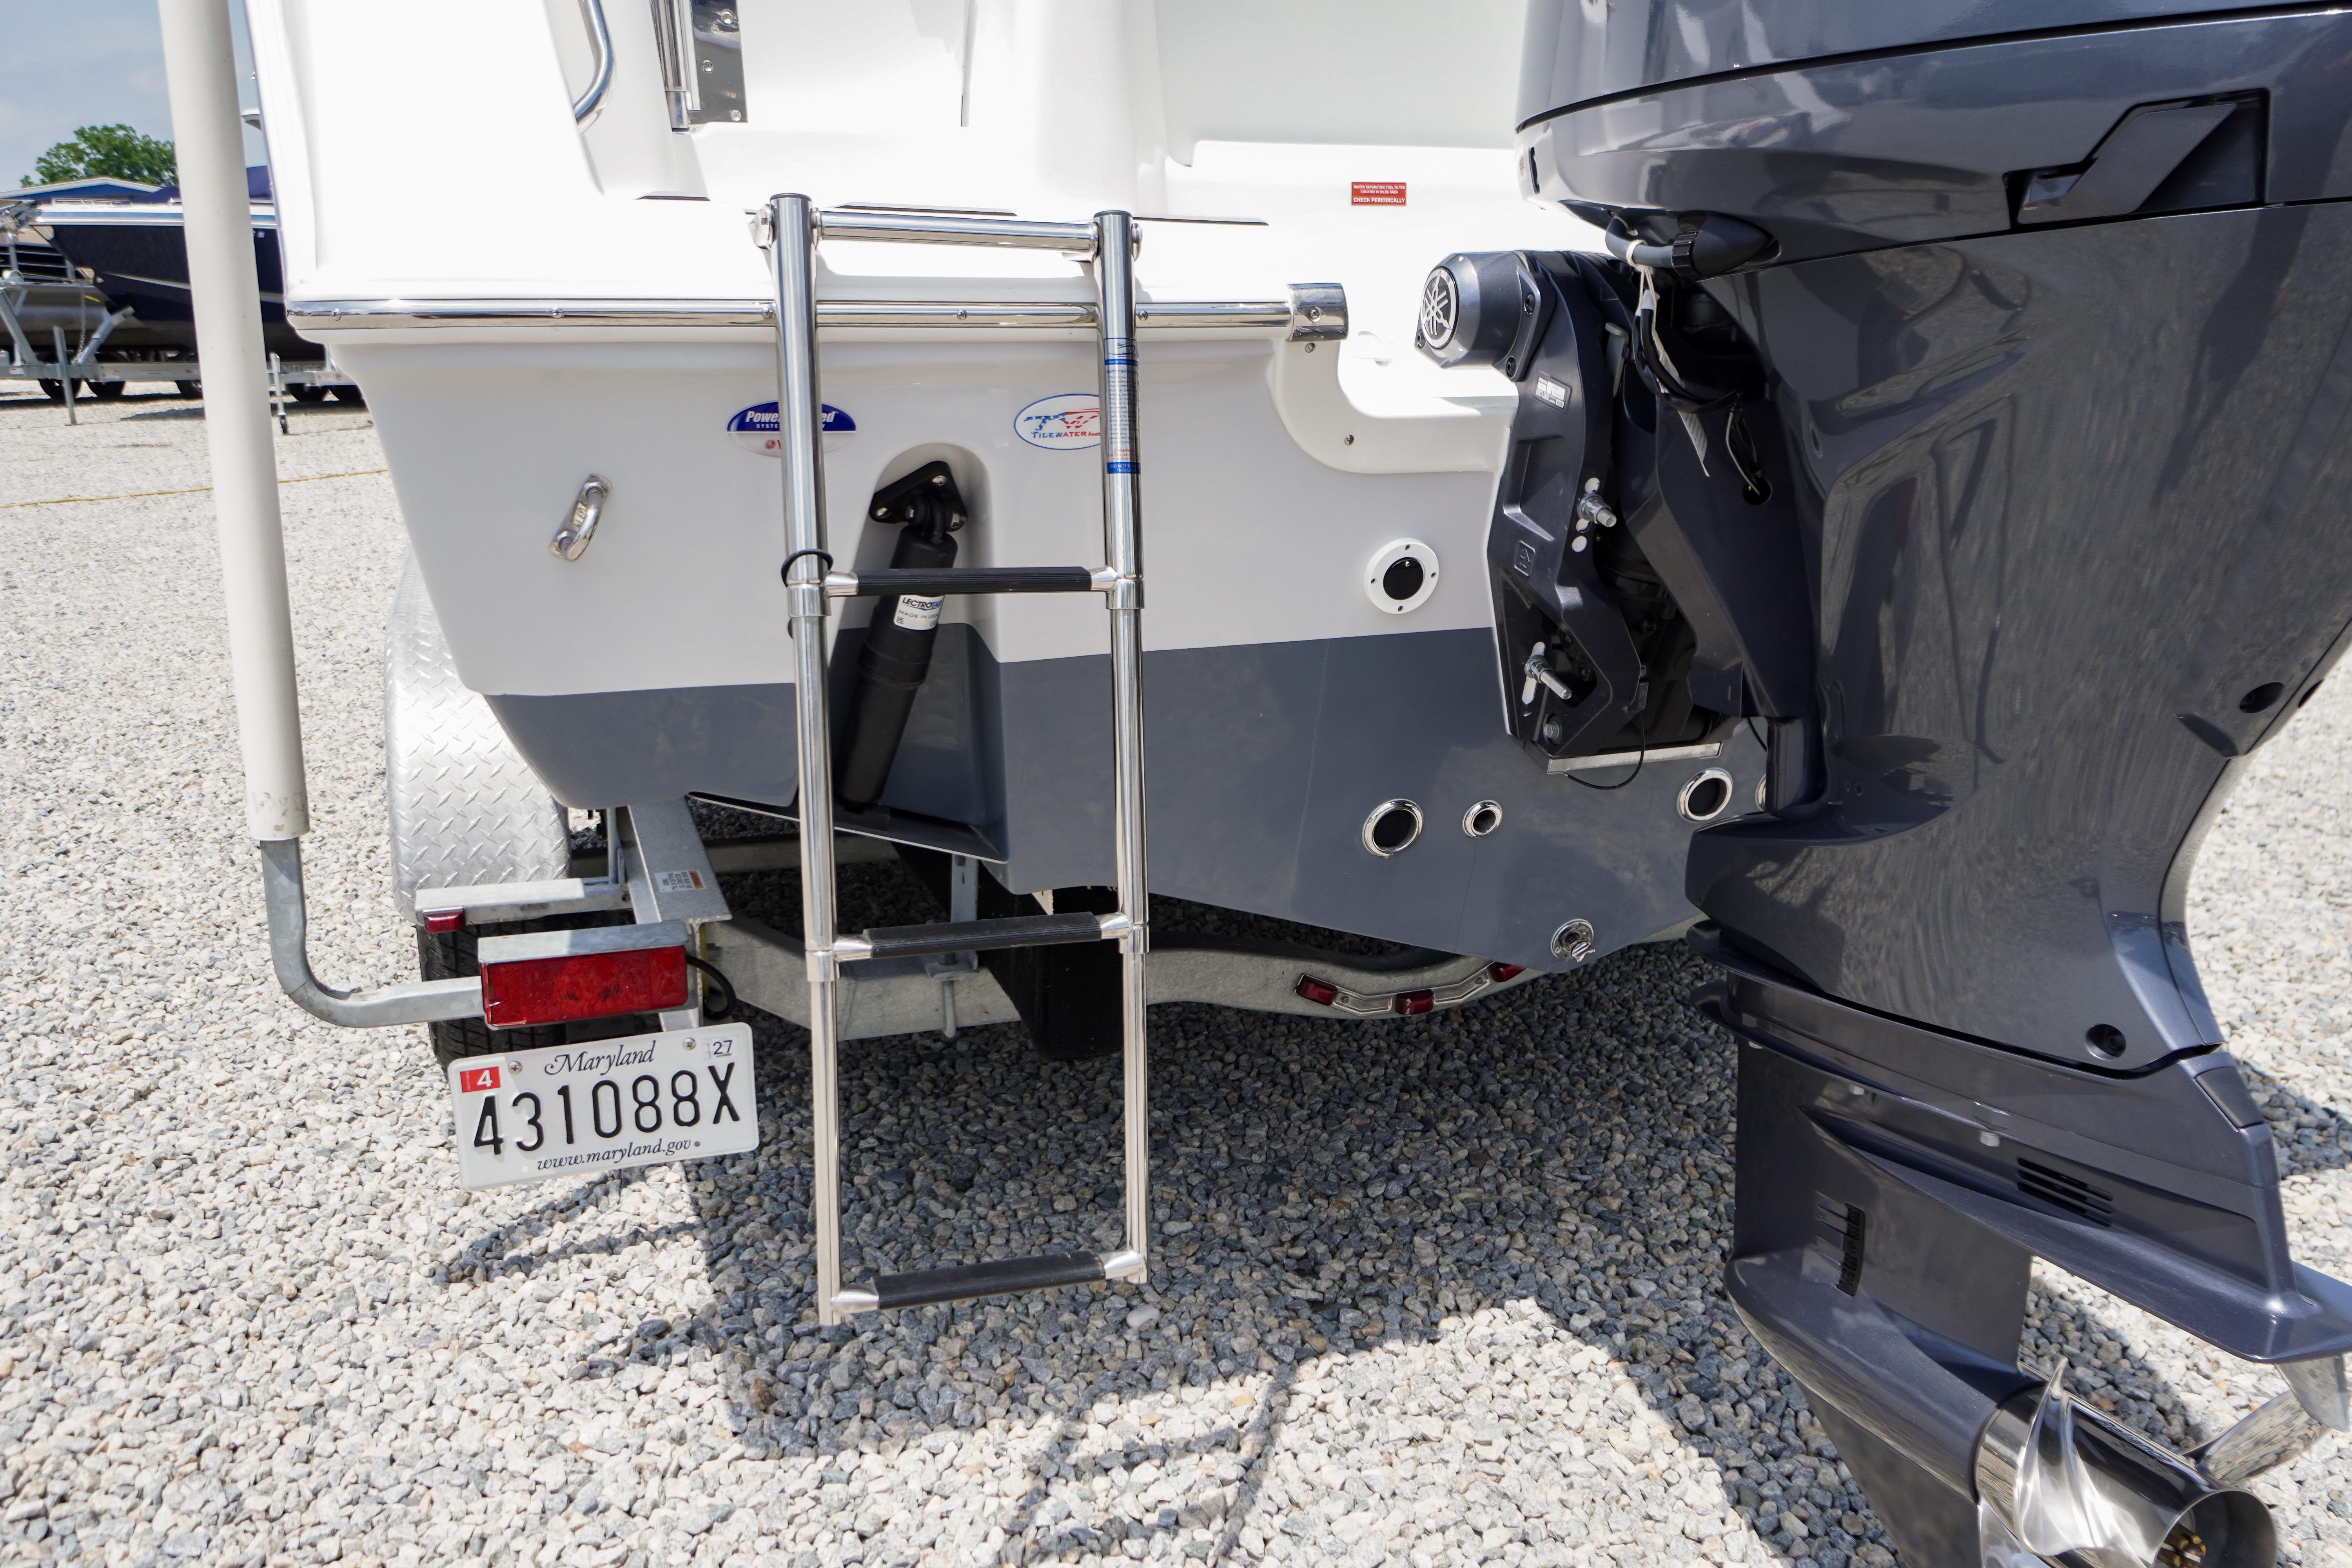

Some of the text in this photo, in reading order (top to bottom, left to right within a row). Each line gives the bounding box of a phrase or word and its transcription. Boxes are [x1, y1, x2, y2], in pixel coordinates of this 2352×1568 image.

[899, 610, 919, 619] MADE
[544, 1040, 657, 1076] Maryland
[713, 1039, 733, 1055] 27
[476, 1069, 493, 1087] 4
[474, 1062, 740, 1155] 431088X
[537, 1138, 691, 1171] www.maryland.gov
